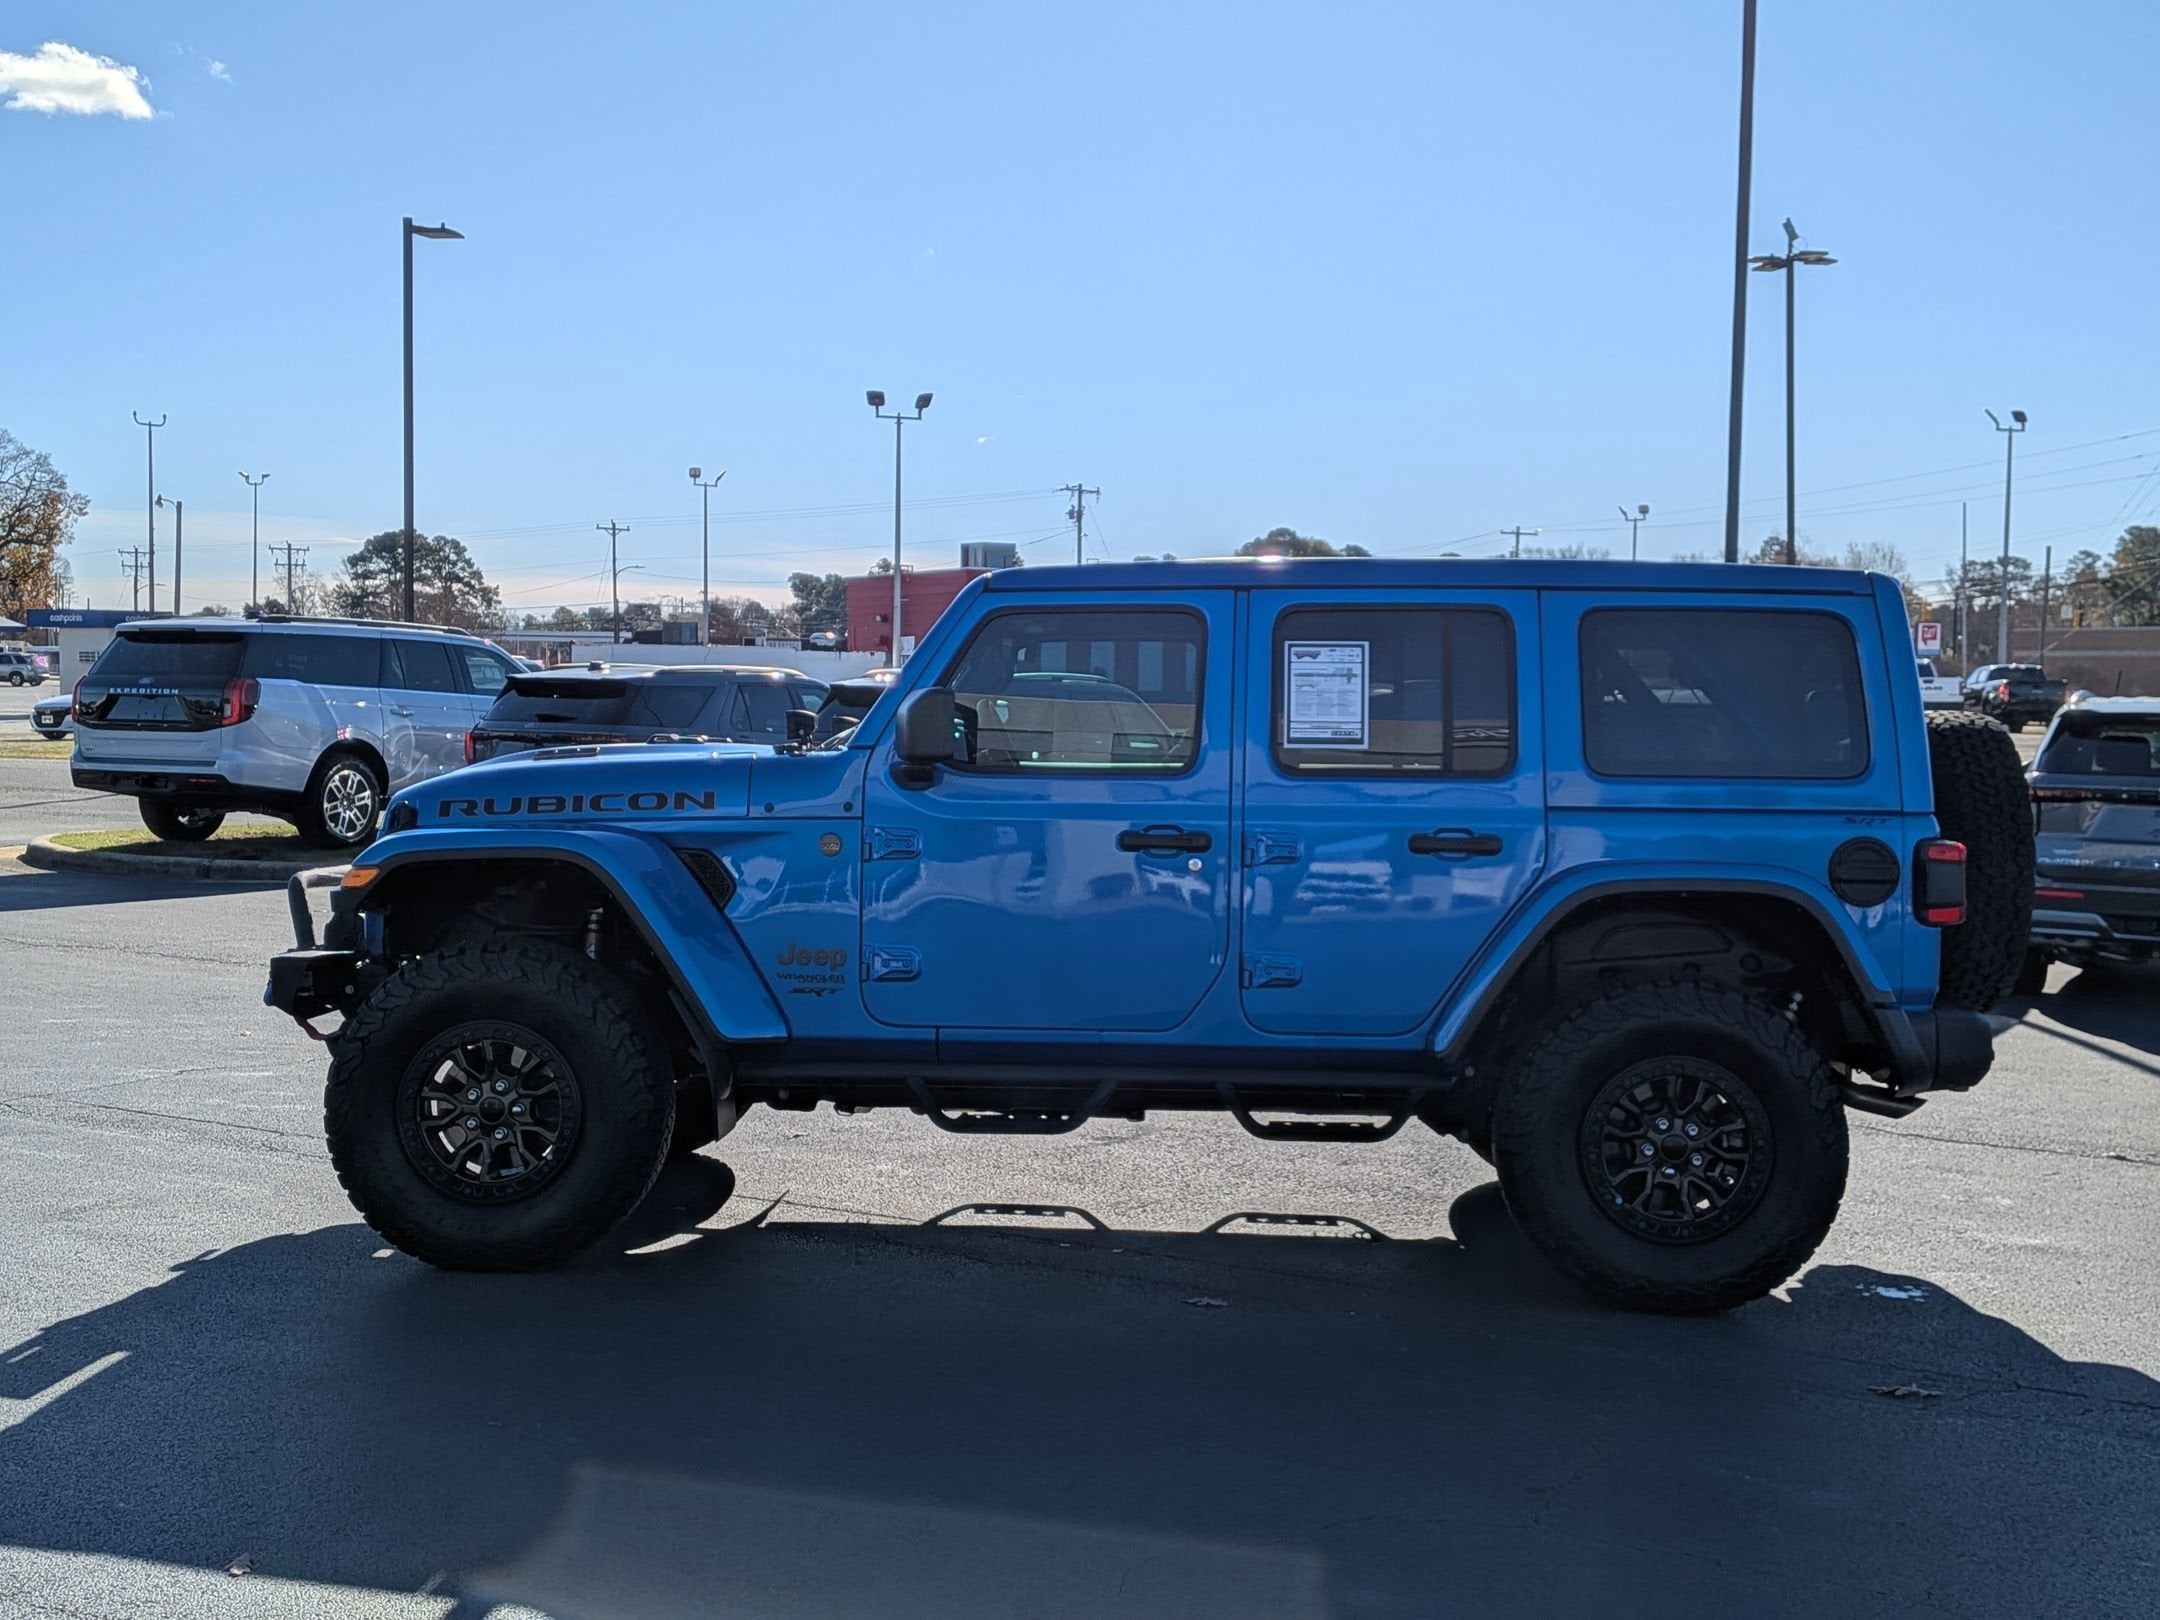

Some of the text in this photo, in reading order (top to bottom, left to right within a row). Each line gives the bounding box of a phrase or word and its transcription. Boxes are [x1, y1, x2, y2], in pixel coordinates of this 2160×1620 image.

[109, 687, 179, 695] EXPEDITION
[436, 790, 717, 819] RUBICON
[776, 943, 847, 971] Jeep
[776, 972, 846, 984] WRANGLER
[788, 987, 845, 997] SRT
